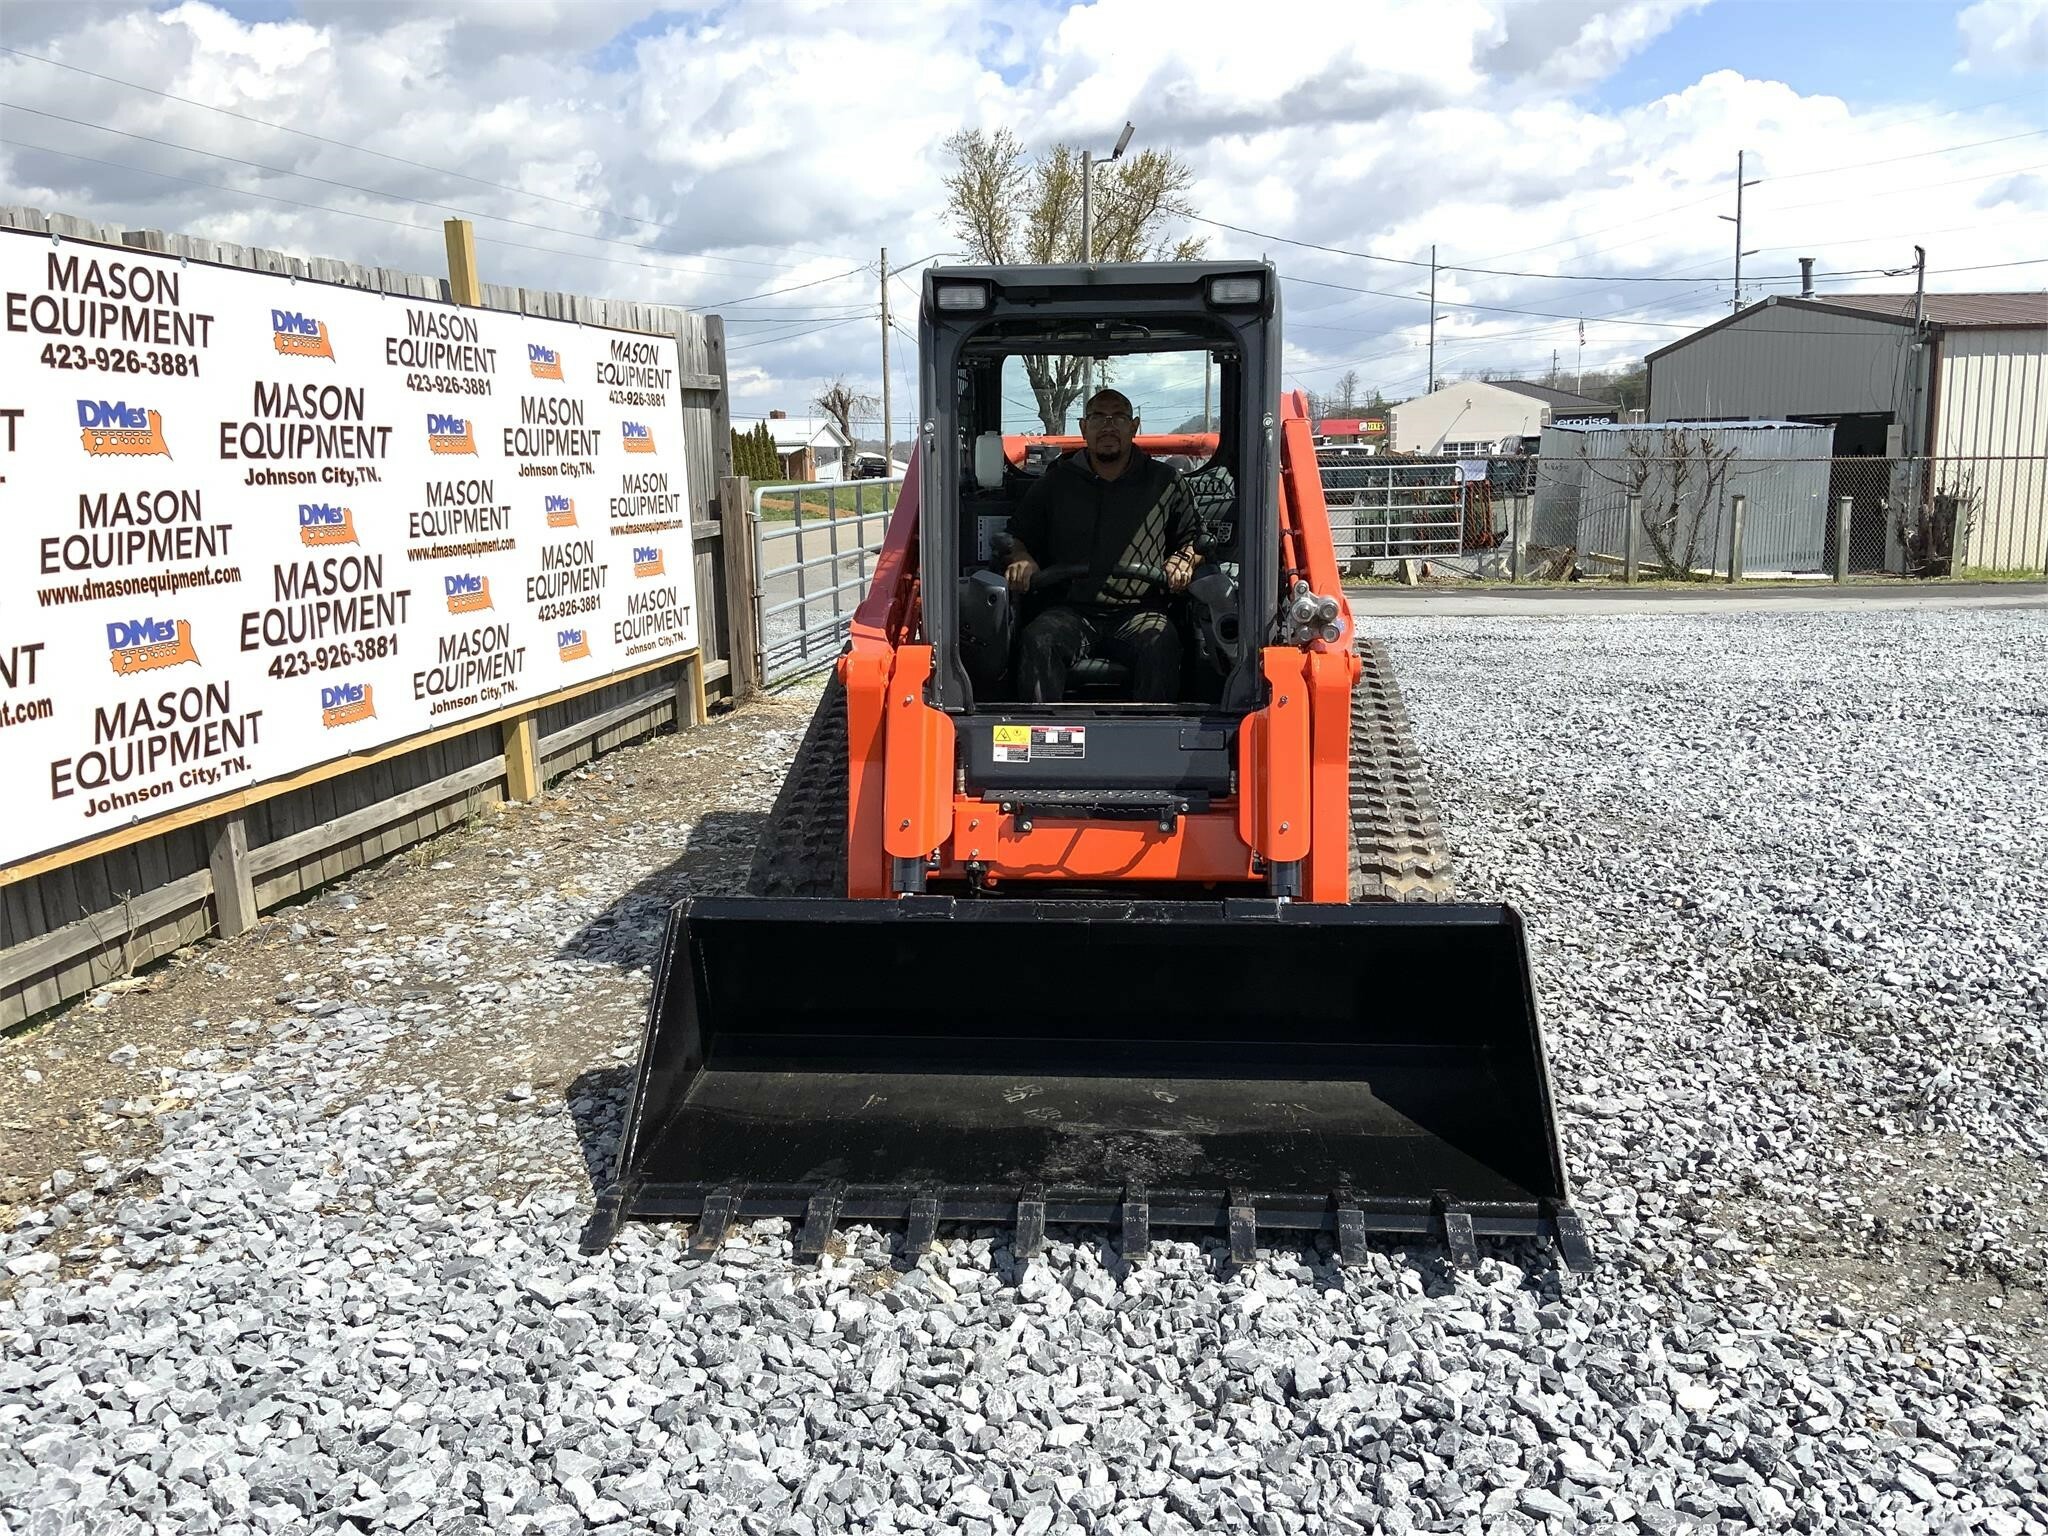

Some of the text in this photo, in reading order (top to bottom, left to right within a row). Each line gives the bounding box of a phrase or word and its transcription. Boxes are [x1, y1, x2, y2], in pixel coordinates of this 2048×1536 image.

[48, 252, 179, 306] MASON
[6, 292, 214, 348] EQUIPMENT
[406, 308, 478, 343] MASON
[41, 343, 200, 377] 423-926-3881
[386, 338, 496, 373] EQUIPMENT
[610, 339, 658, 365] MASON
[406, 373, 492, 396] 423-926-3881
[596, 362, 672, 389] EQUIPMENT
[254, 381, 364, 421] MASON
[521, 396, 584, 425] MASON
[609, 389, 666, 407] 423-926-3881
[1555, 416, 1611, 426] erprise
[220, 422, 392, 460] EQUIPMENT
[504, 428, 601, 457] EQUIPMENT
[244, 468, 317, 486] Johnson
[518, 464, 558, 477] Johnson
[622, 473, 668, 494] MASON
[79, 489, 202, 529] MASON
[426, 480, 494, 508] MASON
[610, 494, 680, 519] EQUIPMENT
[409, 506, 511, 539] EQUIPMENT
[610, 519, 683, 536] www.dmasonequipment.com
[40, 524, 233, 574] EQUIPMENT
[407, 537, 516, 562] www.dmasonequipment.com
[542, 540, 594, 572] MASON
[37, 565, 242, 607] www.dmasonequipment.com
[274, 554, 383, 602] MASON
[526, 565, 609, 603] EQUIPMENT
[538, 594, 602, 622] 423-926-3881
[627, 586, 677, 617] MASON
[240, 589, 412, 652] EQUIPMENT
[614, 606, 691, 644] EQUIPMENT
[268, 632, 399, 679] 423-926-3881
[438, 623, 510, 664] MASON
[625, 640, 656, 657] Johnson
[413, 647, 526, 700] EQUIPMENT
[94, 680, 230, 745] MASON
[429, 692, 479, 716] Johnson
[51, 710, 263, 800] EQUIPMENT
[84, 779, 174, 818] Johnson
